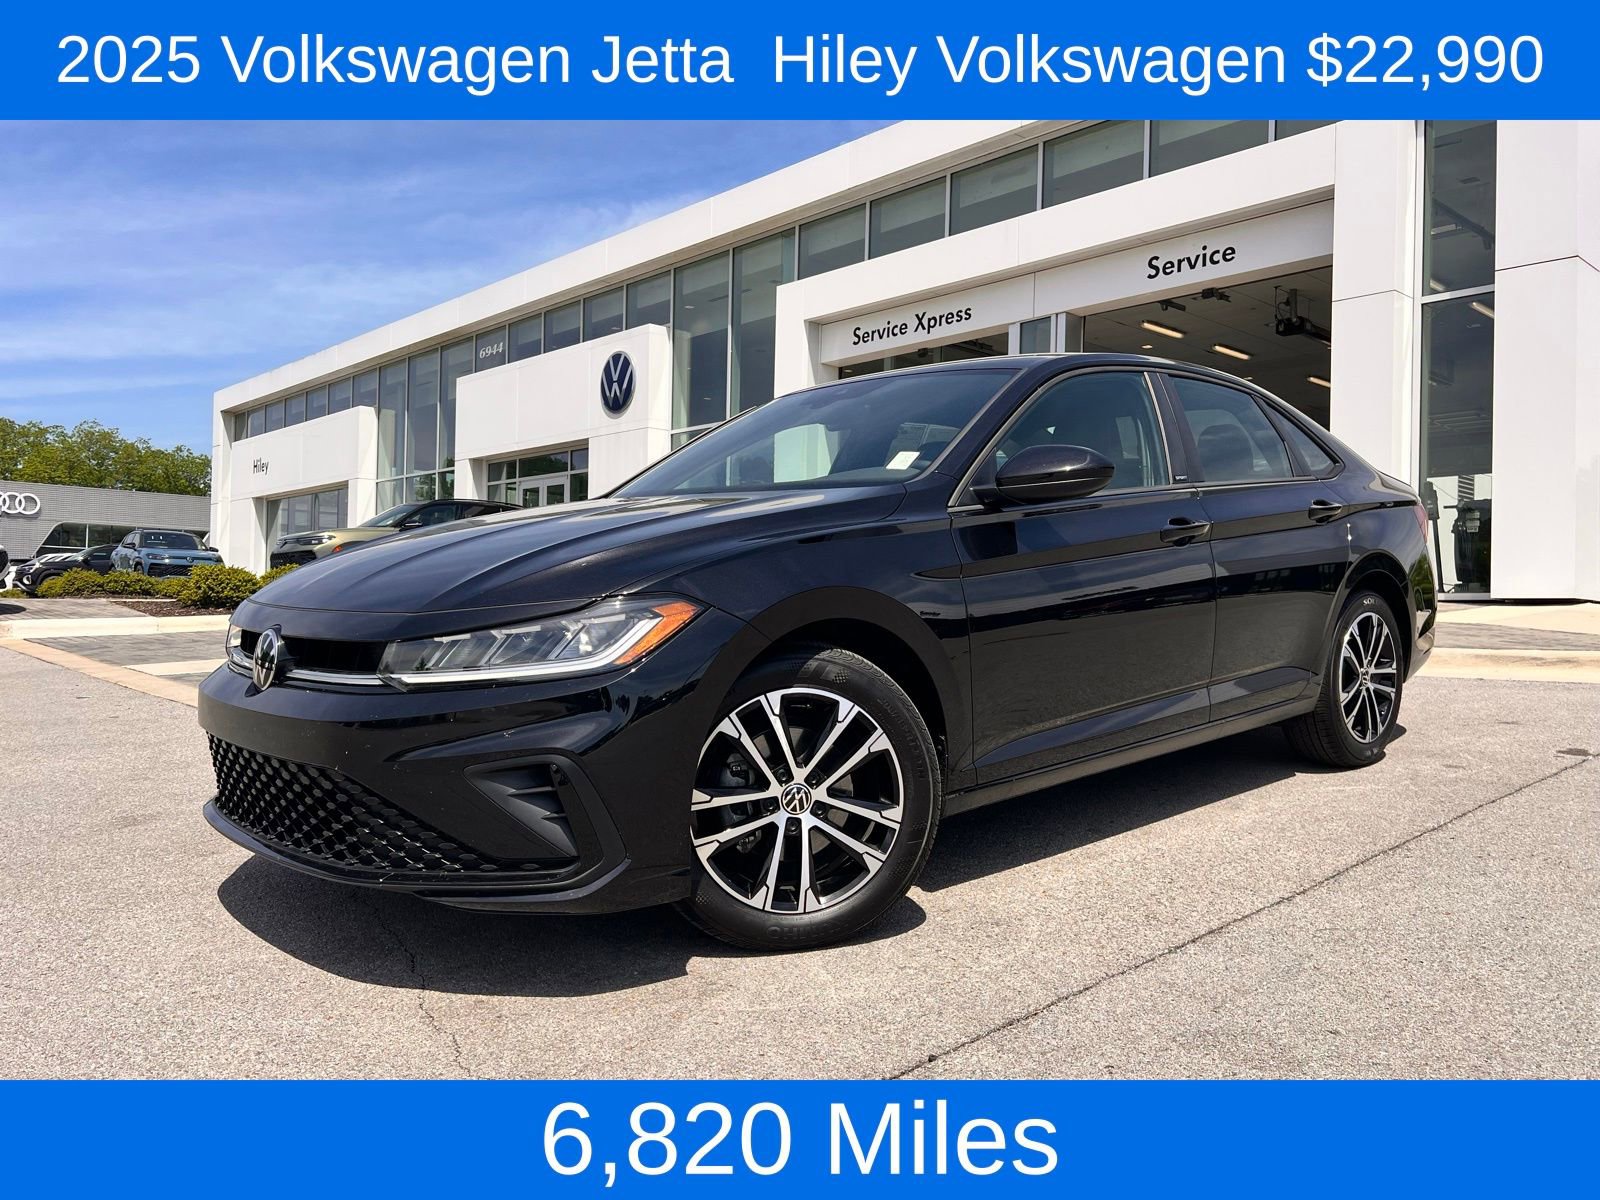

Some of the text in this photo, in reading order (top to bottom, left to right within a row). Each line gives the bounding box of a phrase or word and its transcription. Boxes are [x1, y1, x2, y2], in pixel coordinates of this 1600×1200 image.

[1147, 245, 1236, 279] Service
[852, 307, 972, 345] Service Xpress
[479, 342, 504, 359] 6944
[252, 456, 270, 476] Hiley
